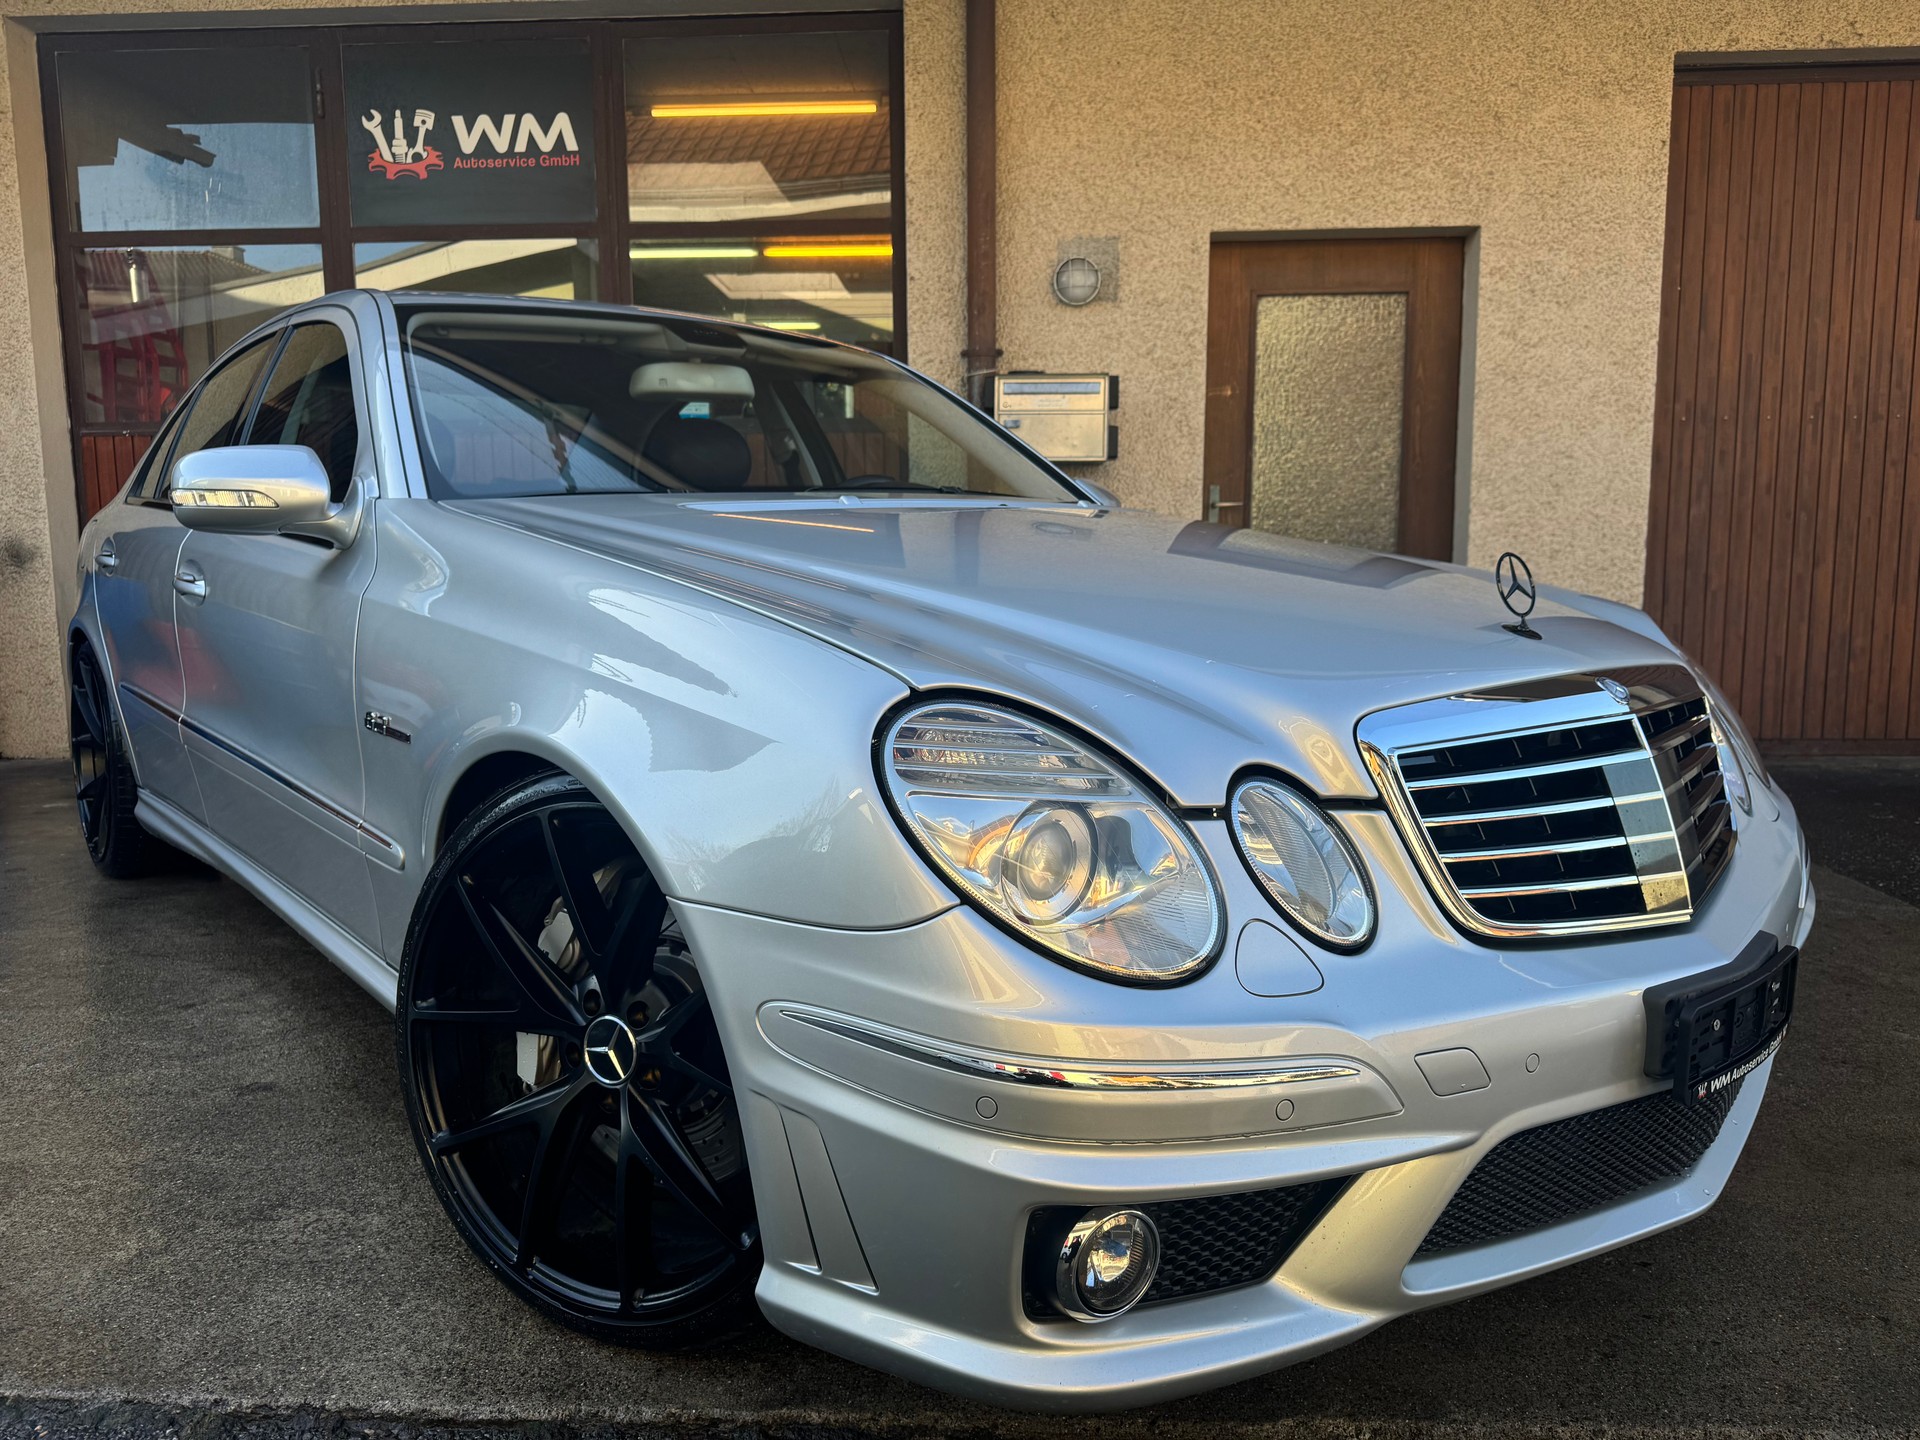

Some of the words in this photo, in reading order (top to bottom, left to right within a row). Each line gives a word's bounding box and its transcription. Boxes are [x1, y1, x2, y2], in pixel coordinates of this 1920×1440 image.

[451, 112, 579, 154] WM
[454, 156, 536, 168] Autoservice
[539, 154, 580, 167] GmbH
[1711, 1072, 1732, 1093] WM
[1732, 1048, 1769, 1081] Autoservice
